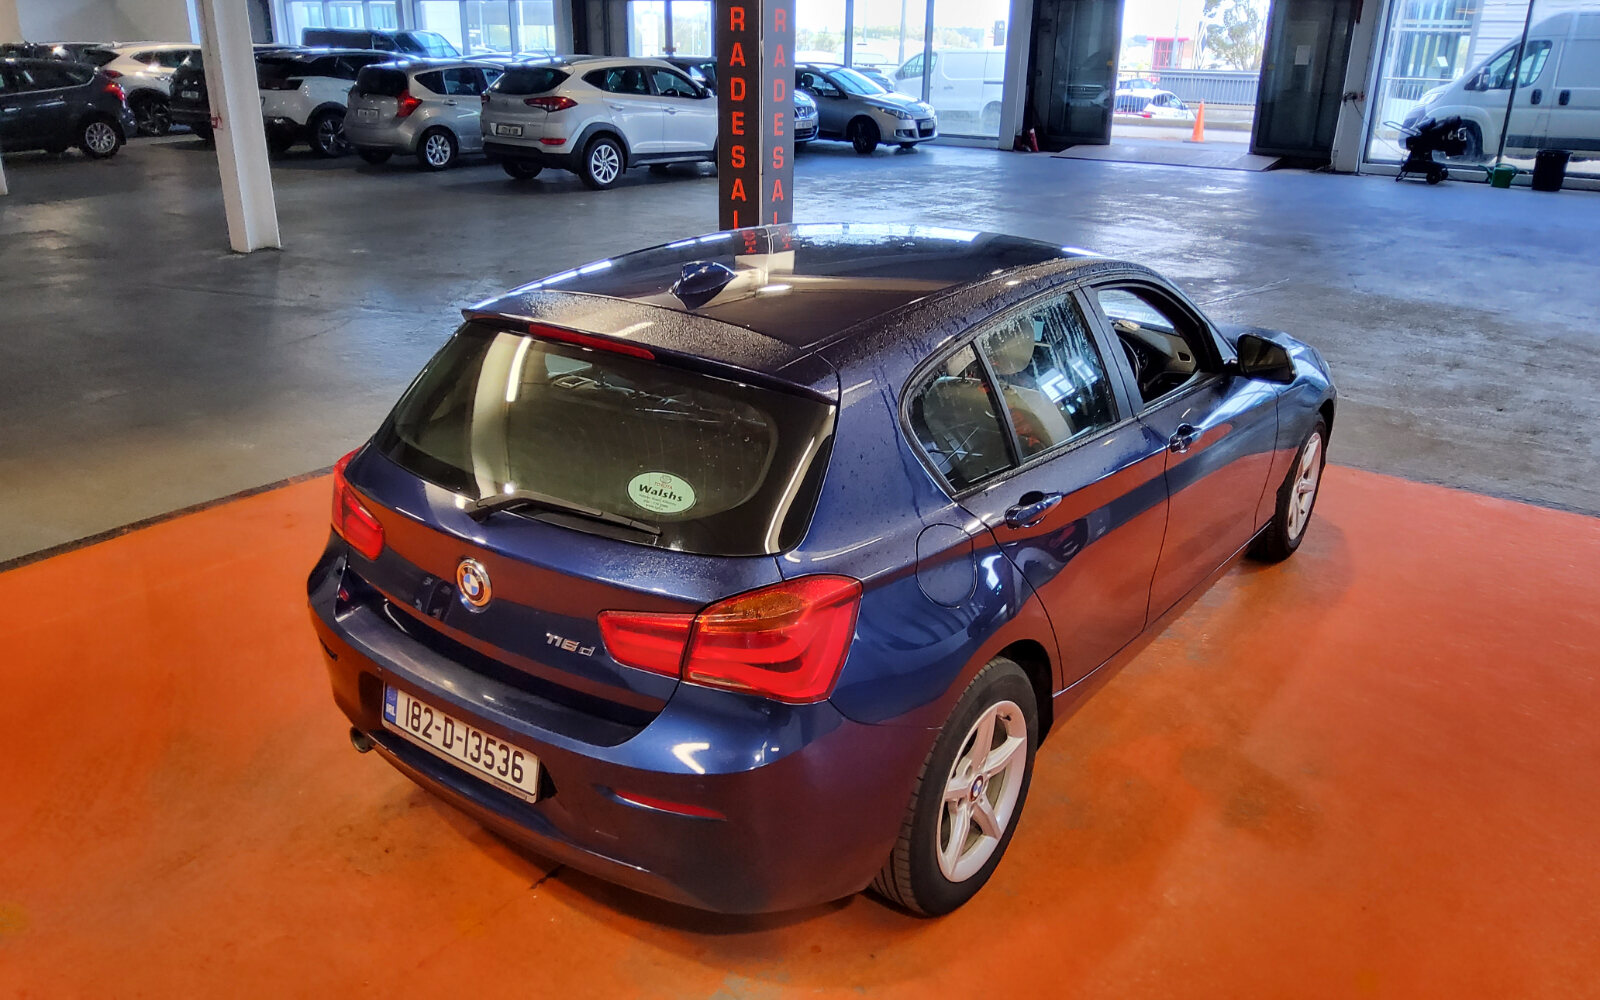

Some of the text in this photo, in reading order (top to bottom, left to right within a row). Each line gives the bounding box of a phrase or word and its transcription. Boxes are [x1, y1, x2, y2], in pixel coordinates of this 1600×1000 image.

[639, 484, 683, 501] Walshs
[655, 481, 673, 490] TOYOTA
[405, 697, 525, 784] 182-D-13536
